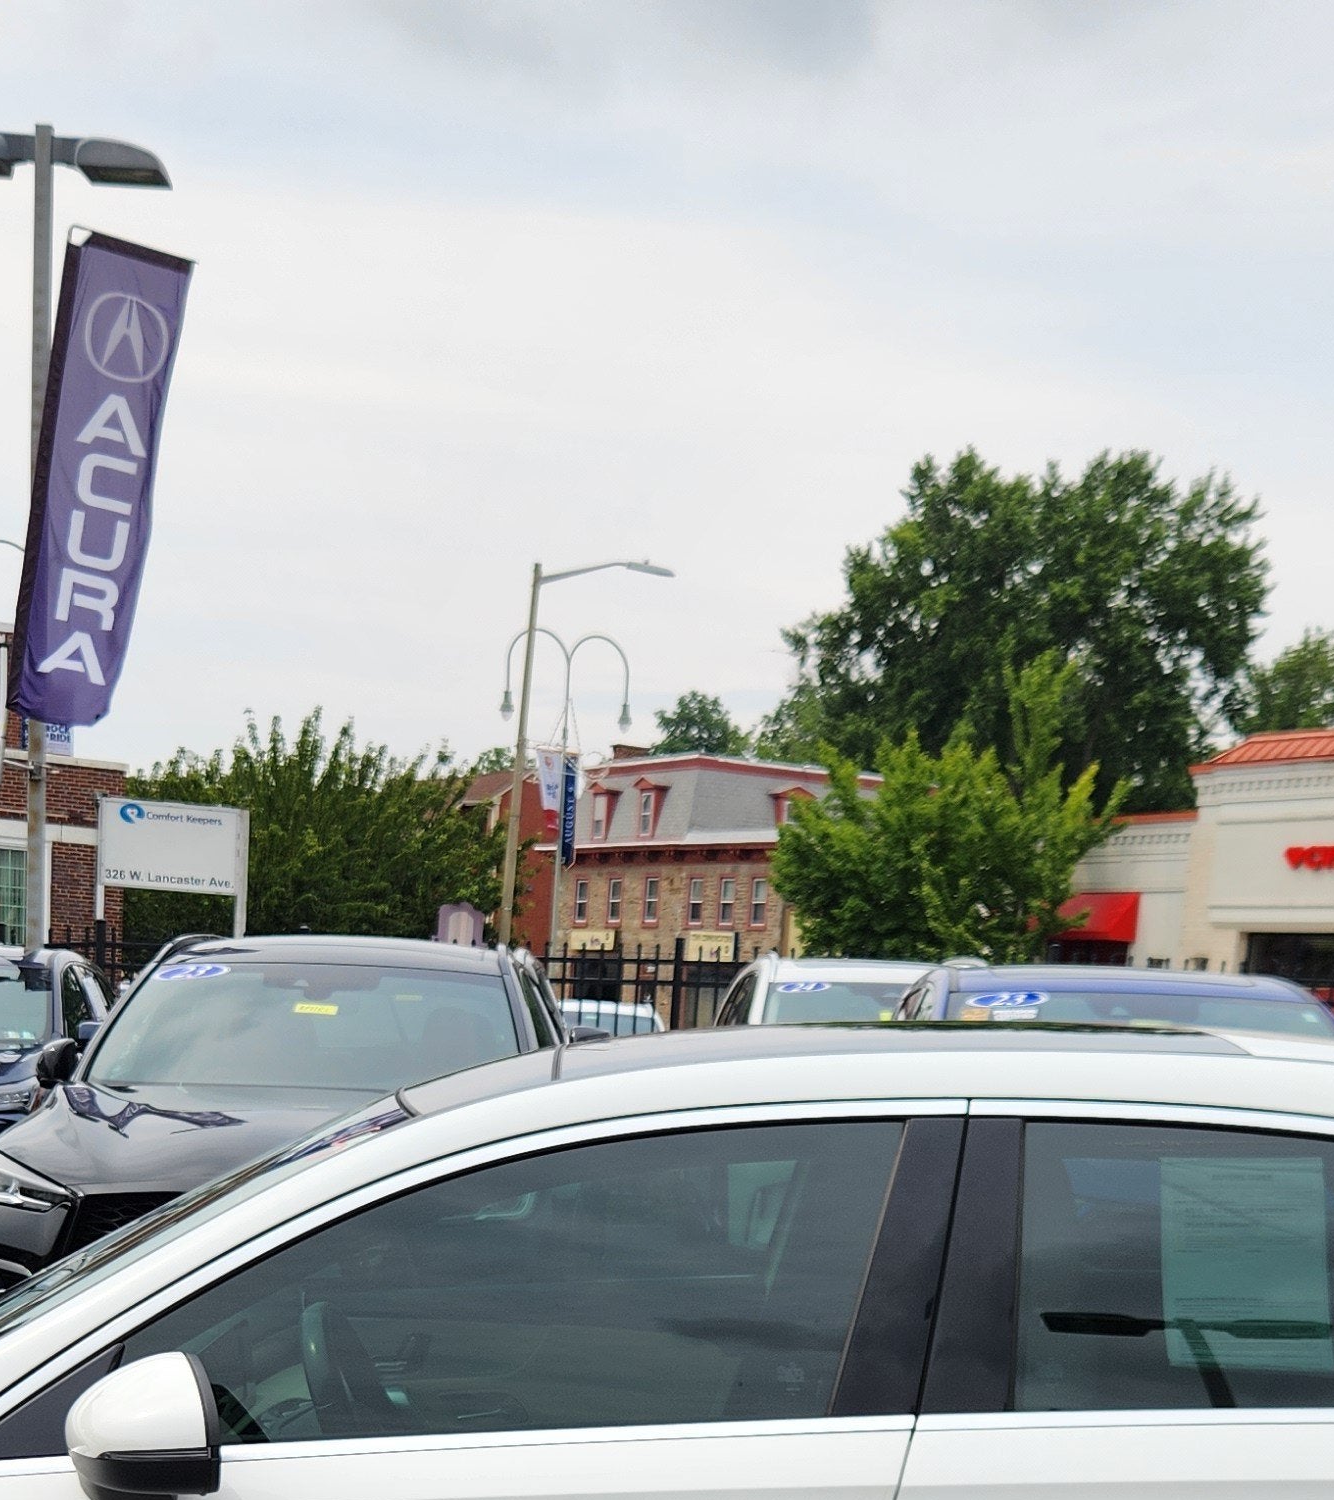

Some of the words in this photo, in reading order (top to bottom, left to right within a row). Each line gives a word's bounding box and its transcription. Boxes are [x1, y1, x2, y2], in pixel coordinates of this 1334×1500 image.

[37, 394, 147, 686] ACURA
[146, 811, 184, 823] Comfort
[186, 814, 223, 826] Keepers
[564, 800, 575, 843] AUGUST
[129, 870, 144, 882] W.
[147, 872, 206, 887] Lancaster
[208, 876, 235, 889] Ave.
[990, 992, 1029, 1007] 23
